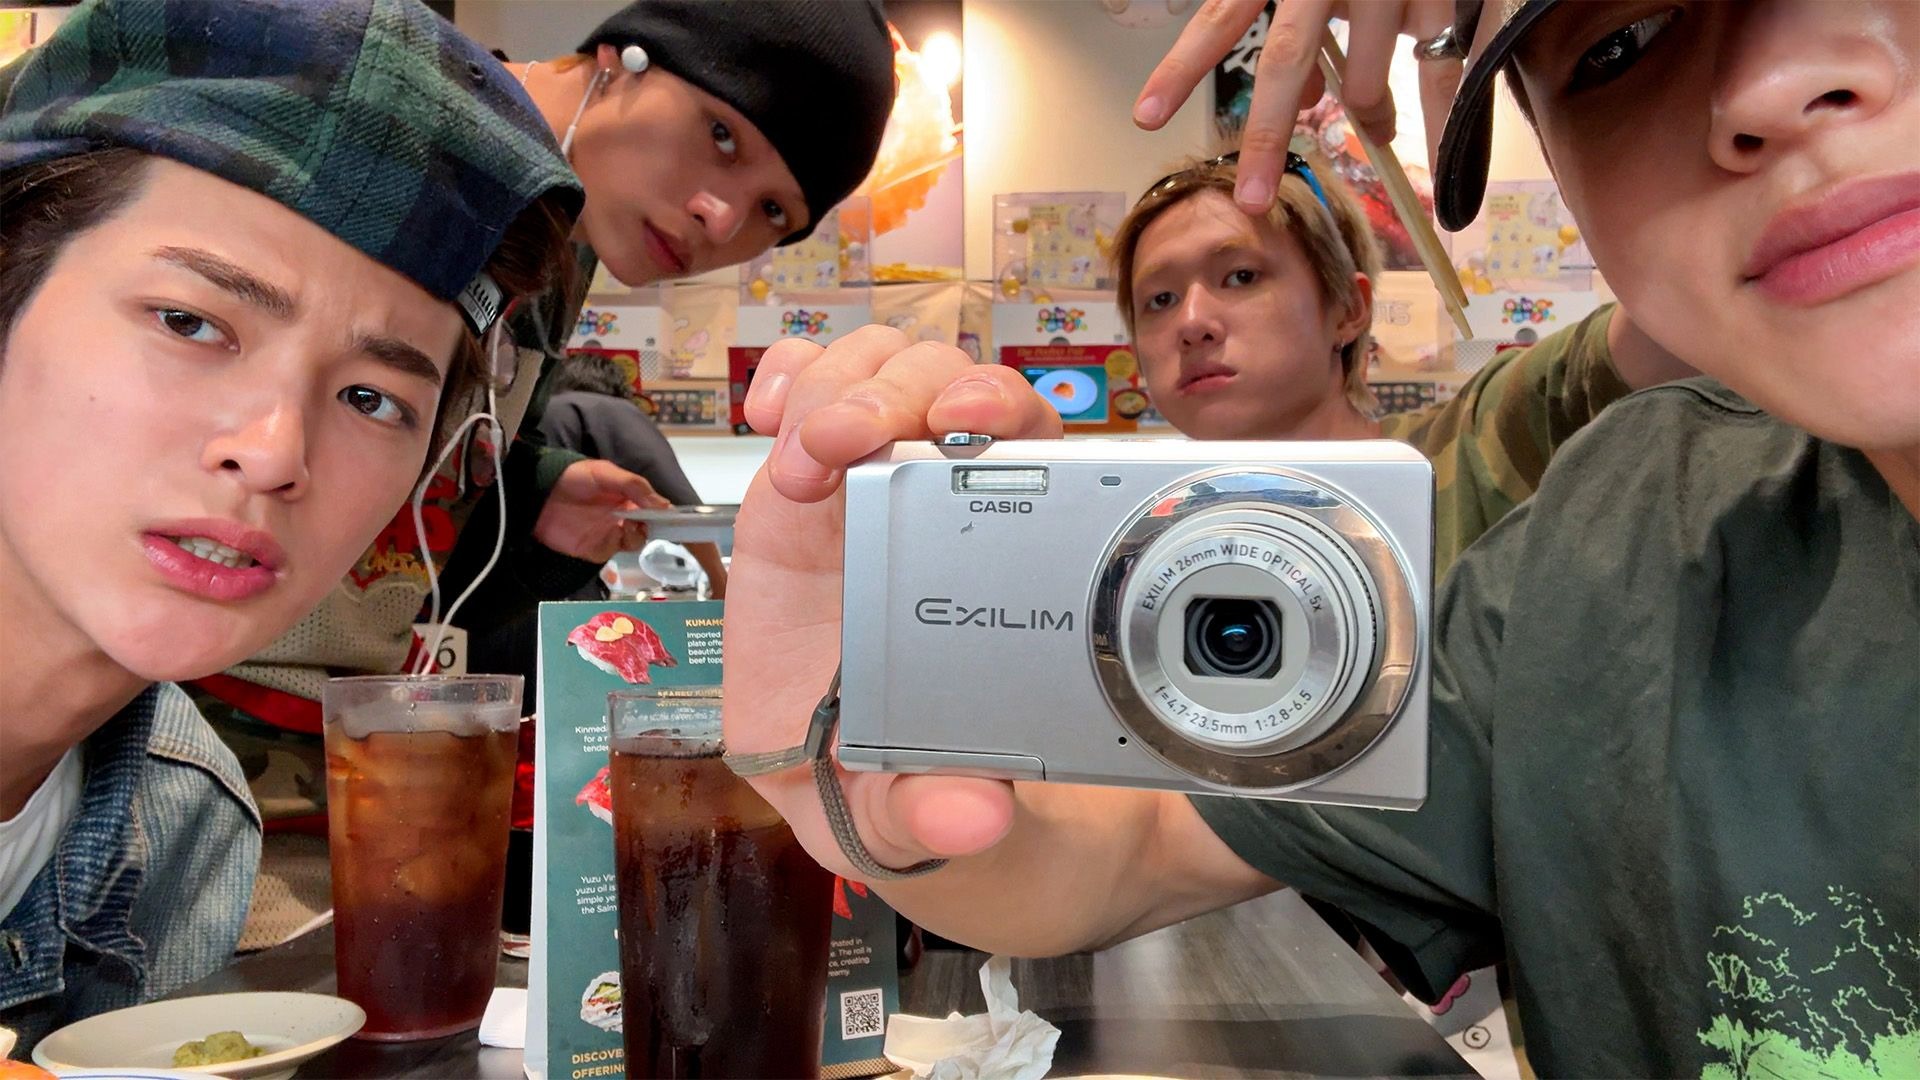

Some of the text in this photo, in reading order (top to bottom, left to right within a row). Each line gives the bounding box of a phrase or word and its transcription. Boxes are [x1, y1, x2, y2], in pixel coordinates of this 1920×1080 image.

[969, 500, 1033, 514] CASIO
[1143, 567, 1177, 611] EXILIM
[1175, 547, 1217, 572] 26mm
[1220, 543, 1259, 559] WIDE
[1262, 550, 1313, 595] OPTICAL
[915, 597, 1073, 631] EXILIM
[686, 631, 721, 640] Imported
[687, 640, 706, 648] plate
[689, 657, 706, 665] beef
[1154, 685, 1312, 735] f=4.7-23.5mm 1:2.8-6.5
[583, 735, 595, 743] for
[580, 876, 601, 884] Yuzu
[575, 887, 596, 897] yuzu
[597, 884, 608, 893] oil
[577, 896, 604, 905] simple
[581, 906, 595, 915] the
[840, 956, 870, 966] creating
